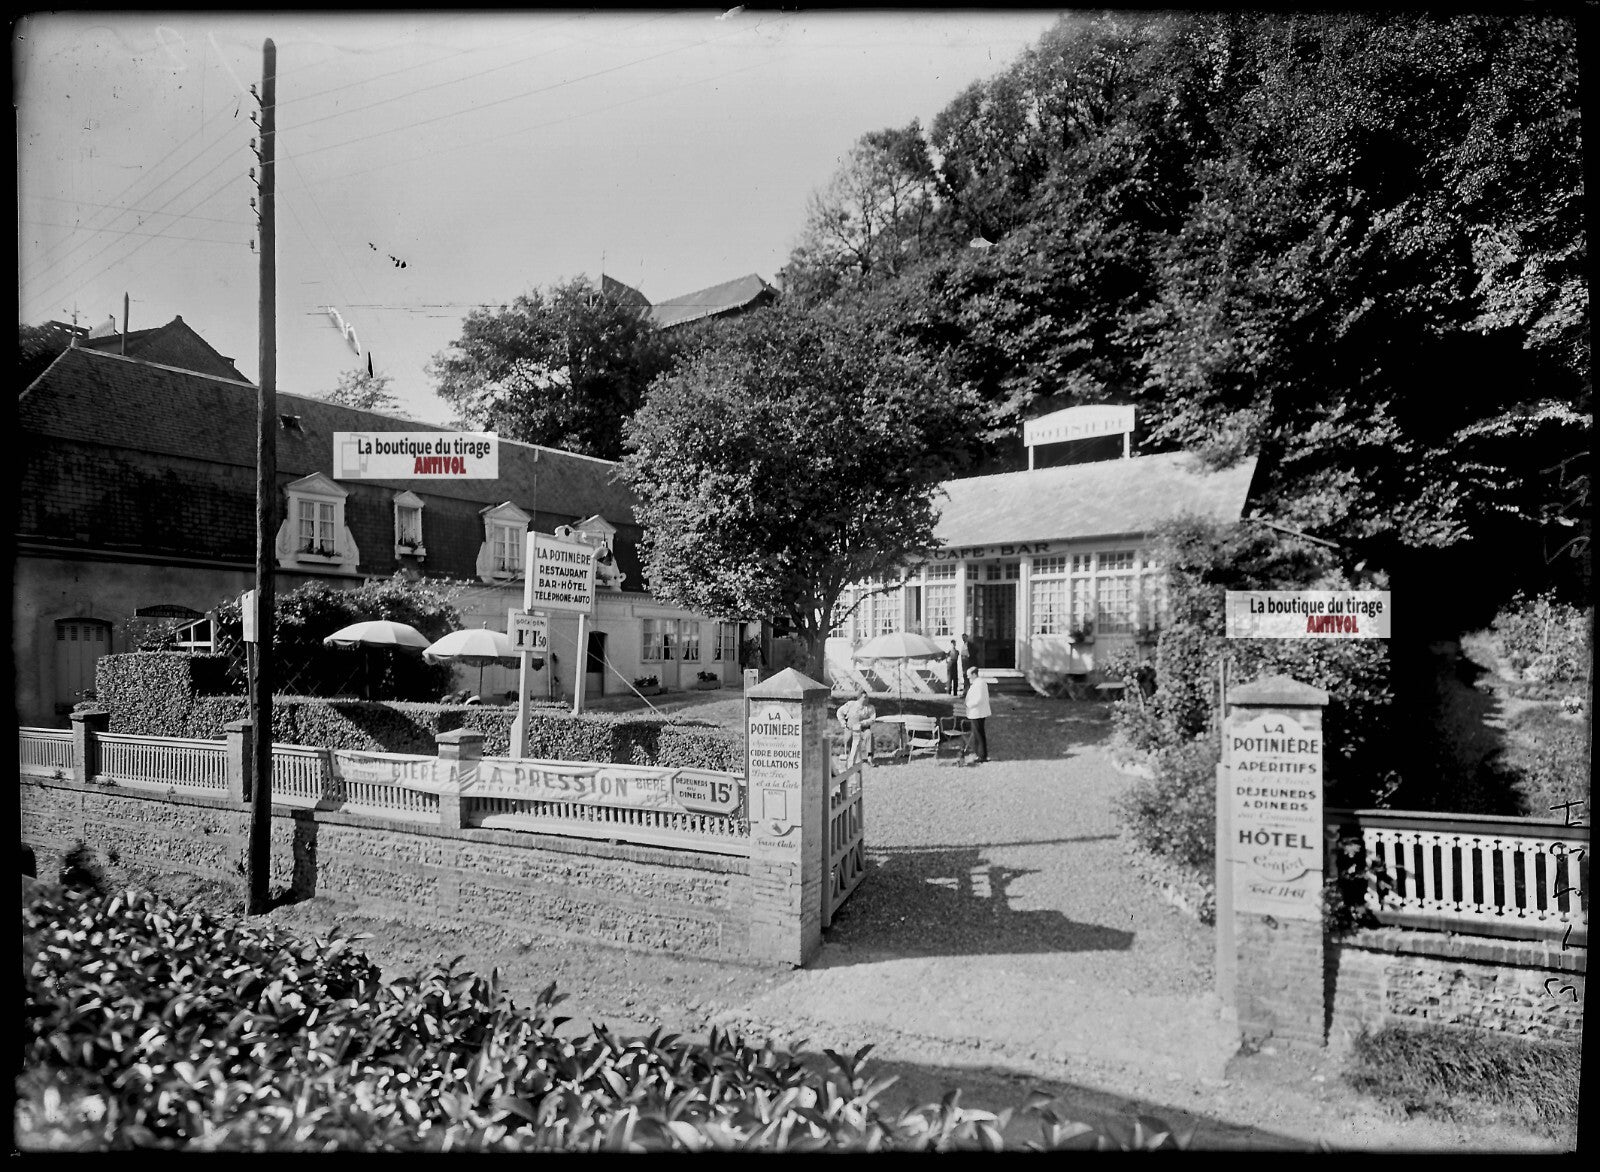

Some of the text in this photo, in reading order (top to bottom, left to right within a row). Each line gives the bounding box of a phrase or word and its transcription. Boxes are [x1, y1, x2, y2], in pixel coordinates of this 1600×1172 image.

[537, 547, 548, 560] LA
[1001, 542, 1050, 556] BAR
[539, 564, 588, 579] RESTAURANT
[768, 712, 781, 721] LA
[1263, 723, 1285, 735] LA
[1234, 737, 1319, 754] POTINIÈRE
[750, 749, 772, 758] CIDRE
[751, 759, 799, 770] COLLATIONS
[514, 767, 628, 797] PRESSION
[1239, 827, 1315, 850] HÔTEL
